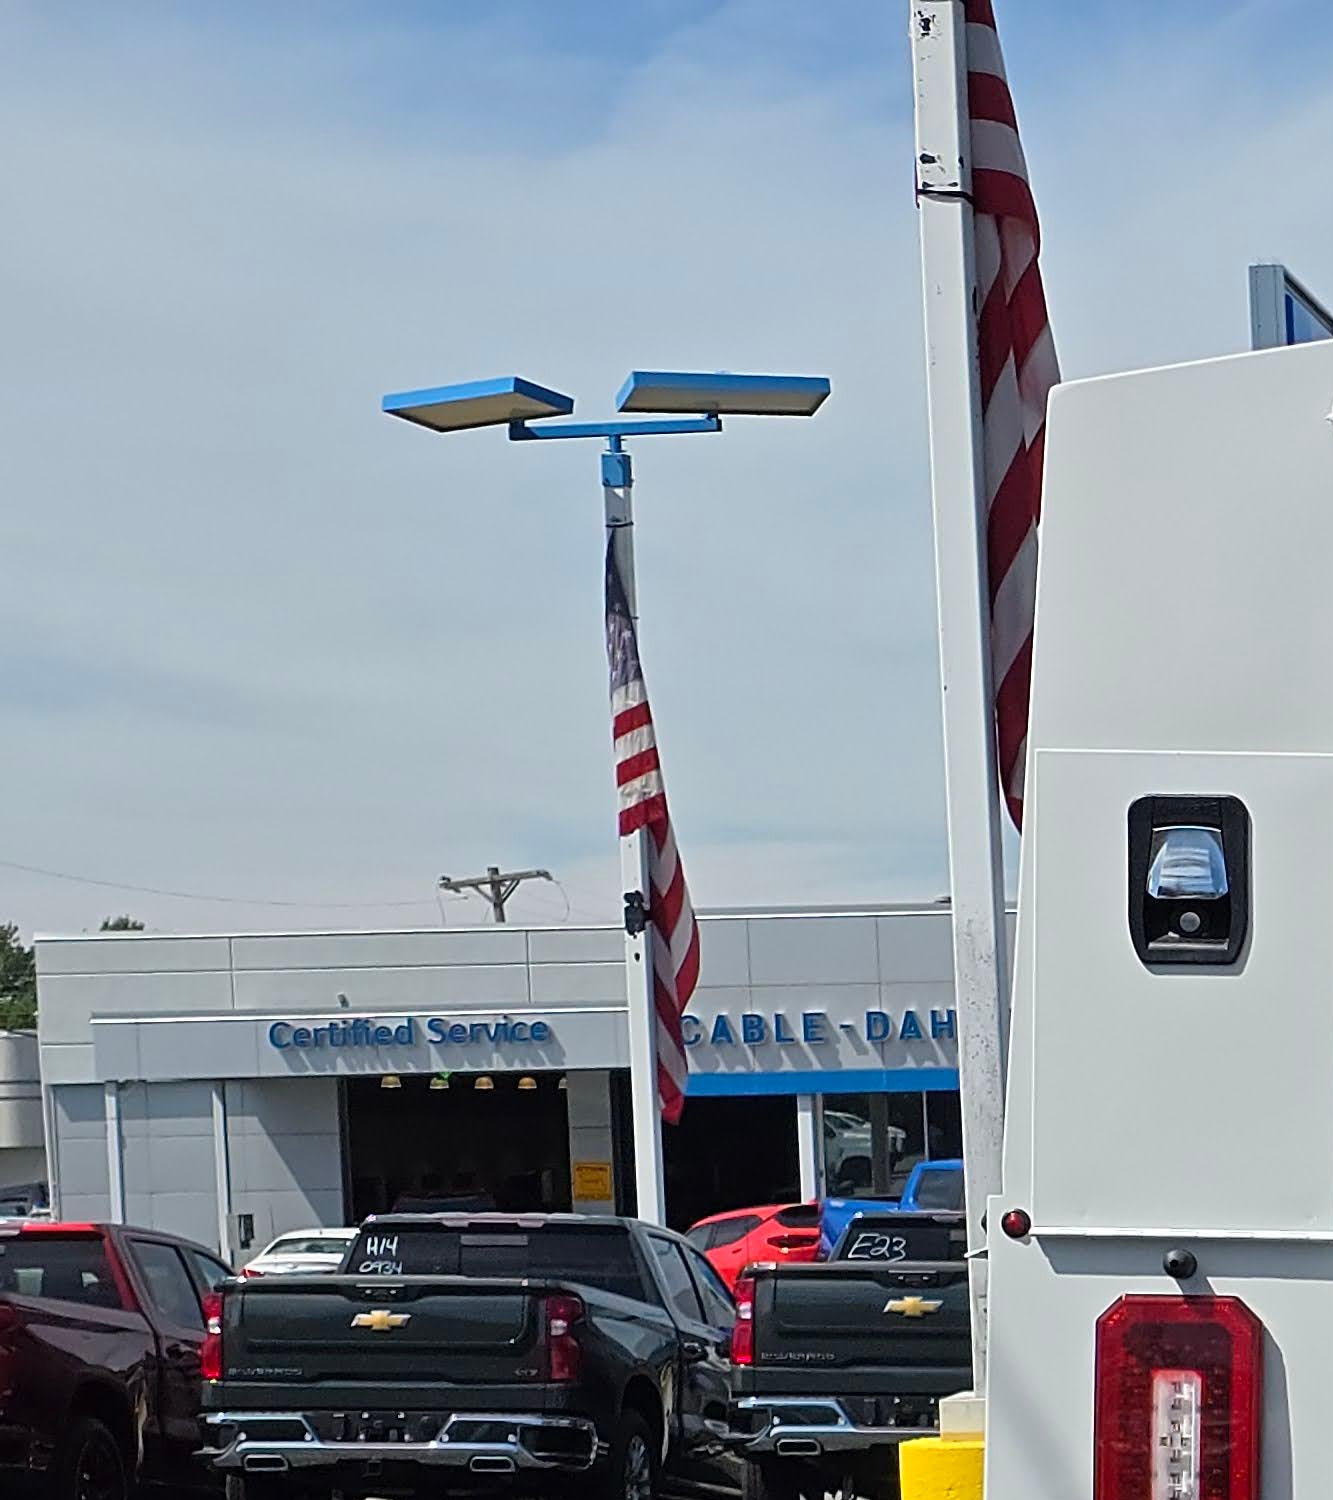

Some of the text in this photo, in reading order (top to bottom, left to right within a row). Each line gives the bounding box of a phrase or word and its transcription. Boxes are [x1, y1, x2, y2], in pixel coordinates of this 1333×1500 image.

[269, 1014, 549, 1049] Certified Service
[366, 1235, 399, 1257] H14
[847, 1232, 907, 1263] E23
